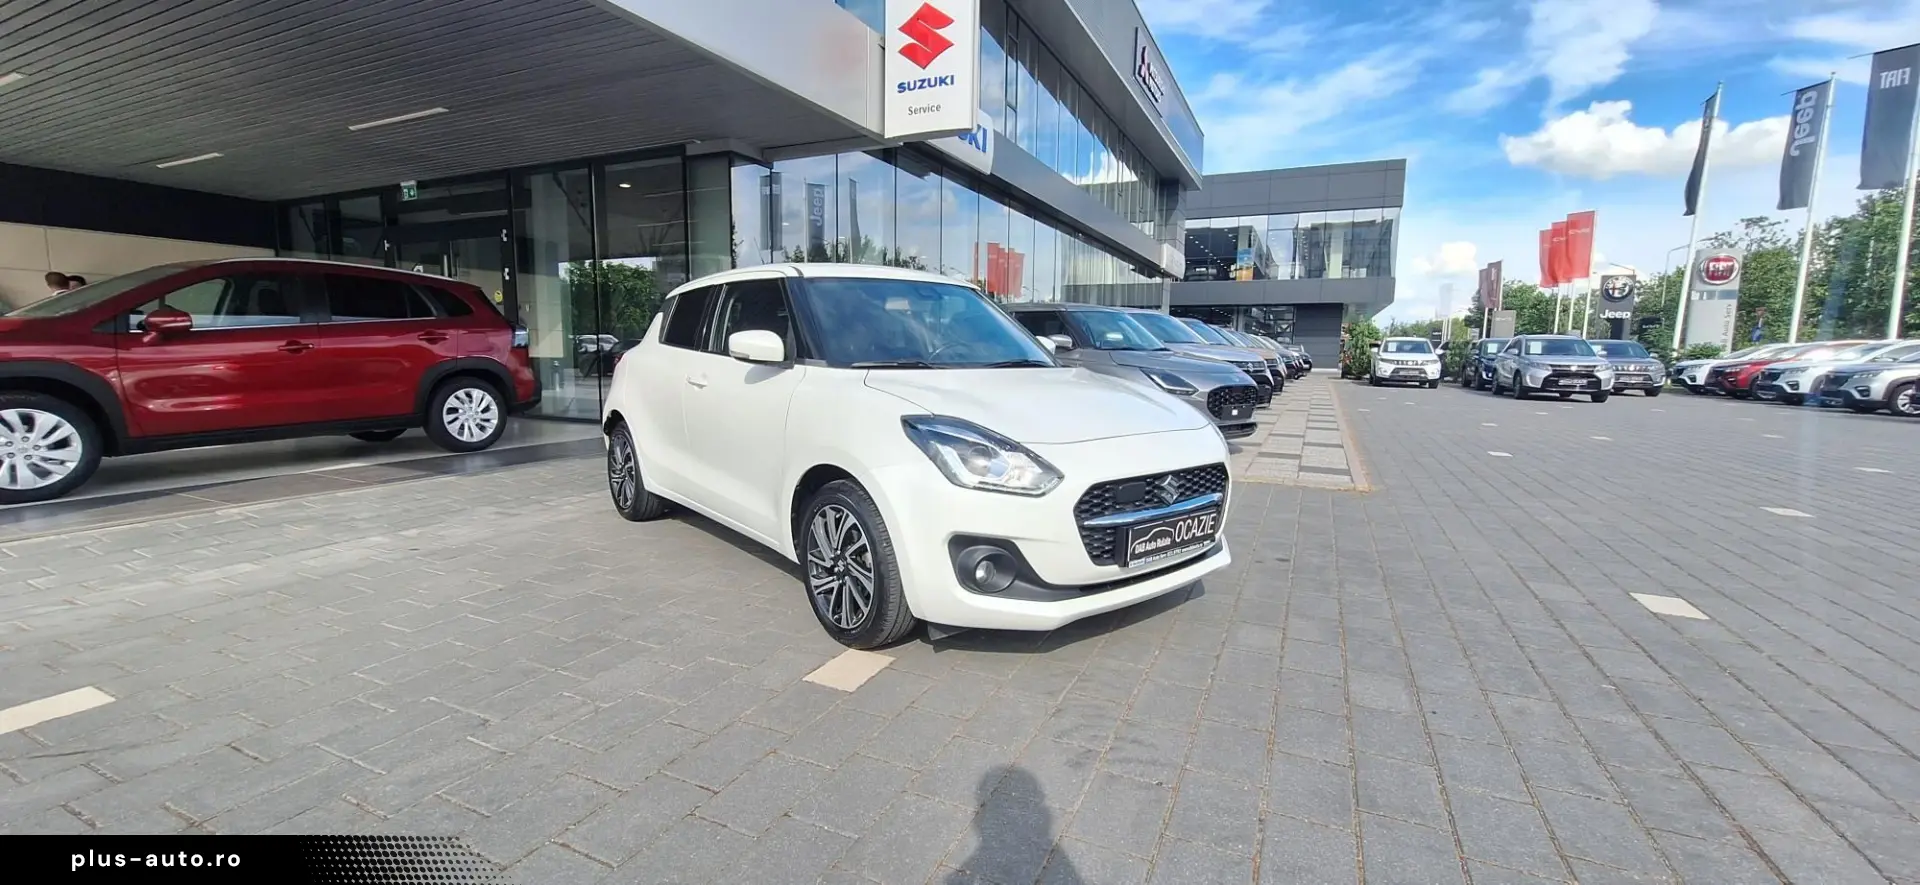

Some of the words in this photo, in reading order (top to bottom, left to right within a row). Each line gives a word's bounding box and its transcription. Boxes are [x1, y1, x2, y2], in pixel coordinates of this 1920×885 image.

[897, 75, 955, 93] SUZUKI
[908, 104, 941, 115] Service
[810, 187, 825, 227] Jeep
[1599, 309, 1631, 319] Jeep
[1175, 513, 1216, 542] OCAZIE
[1145, 540, 1156, 552] Auto
